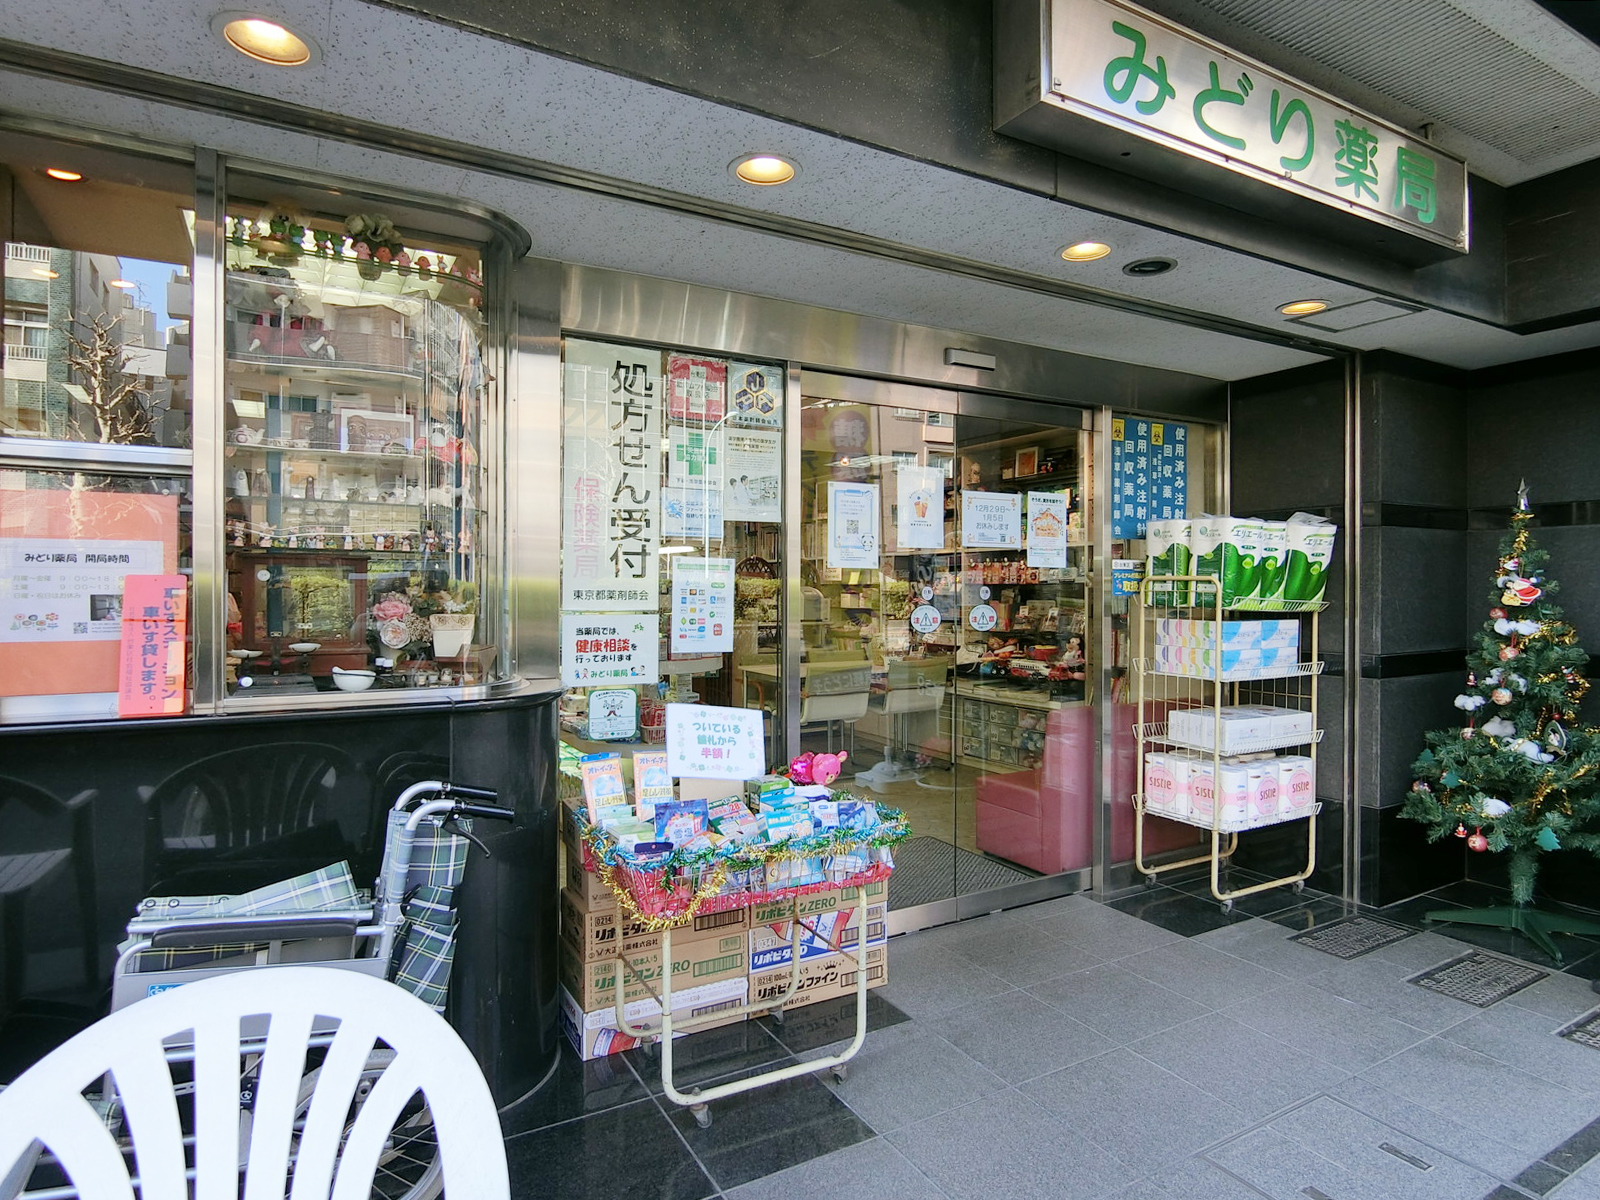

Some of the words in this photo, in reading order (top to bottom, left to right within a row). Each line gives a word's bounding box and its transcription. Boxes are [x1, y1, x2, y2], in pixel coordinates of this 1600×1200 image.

[1103, 20, 1437, 224] みどり薬局
[609, 360, 653, 578] 処方せん受付
[1174, 427, 1185, 520] 使用済み注射
[1124, 440, 1134, 518] 回収薬局
[1136, 422, 1147, 536] 使用済み注射針
[1163, 444, 1172, 519] 回収薬局
[983, 514, 1004, 522] 1月5日
[573, 476, 600, 579] 保険薬局
[975, 522, 1009, 531] お休みします
[24, 553, 78, 563] みどり薬局
[85, 553, 130, 564] 開局時間
[573, 589, 649, 601] 東京都薬剤師会
[575, 627, 621, 636] 当薬局では、
[140, 606, 160, 701] 車いす貸します。
[575, 638, 638, 653] 健康相談を
[575, 654, 633, 664] 行っております
[590, 668, 628, 678] みどり薬局
[692, 721, 742, 735] ついている
[696, 735, 737, 746] 値札から
[604, 938, 658, 955] 大正薬株式会社
[753, 945, 808, 965] リポビタD
